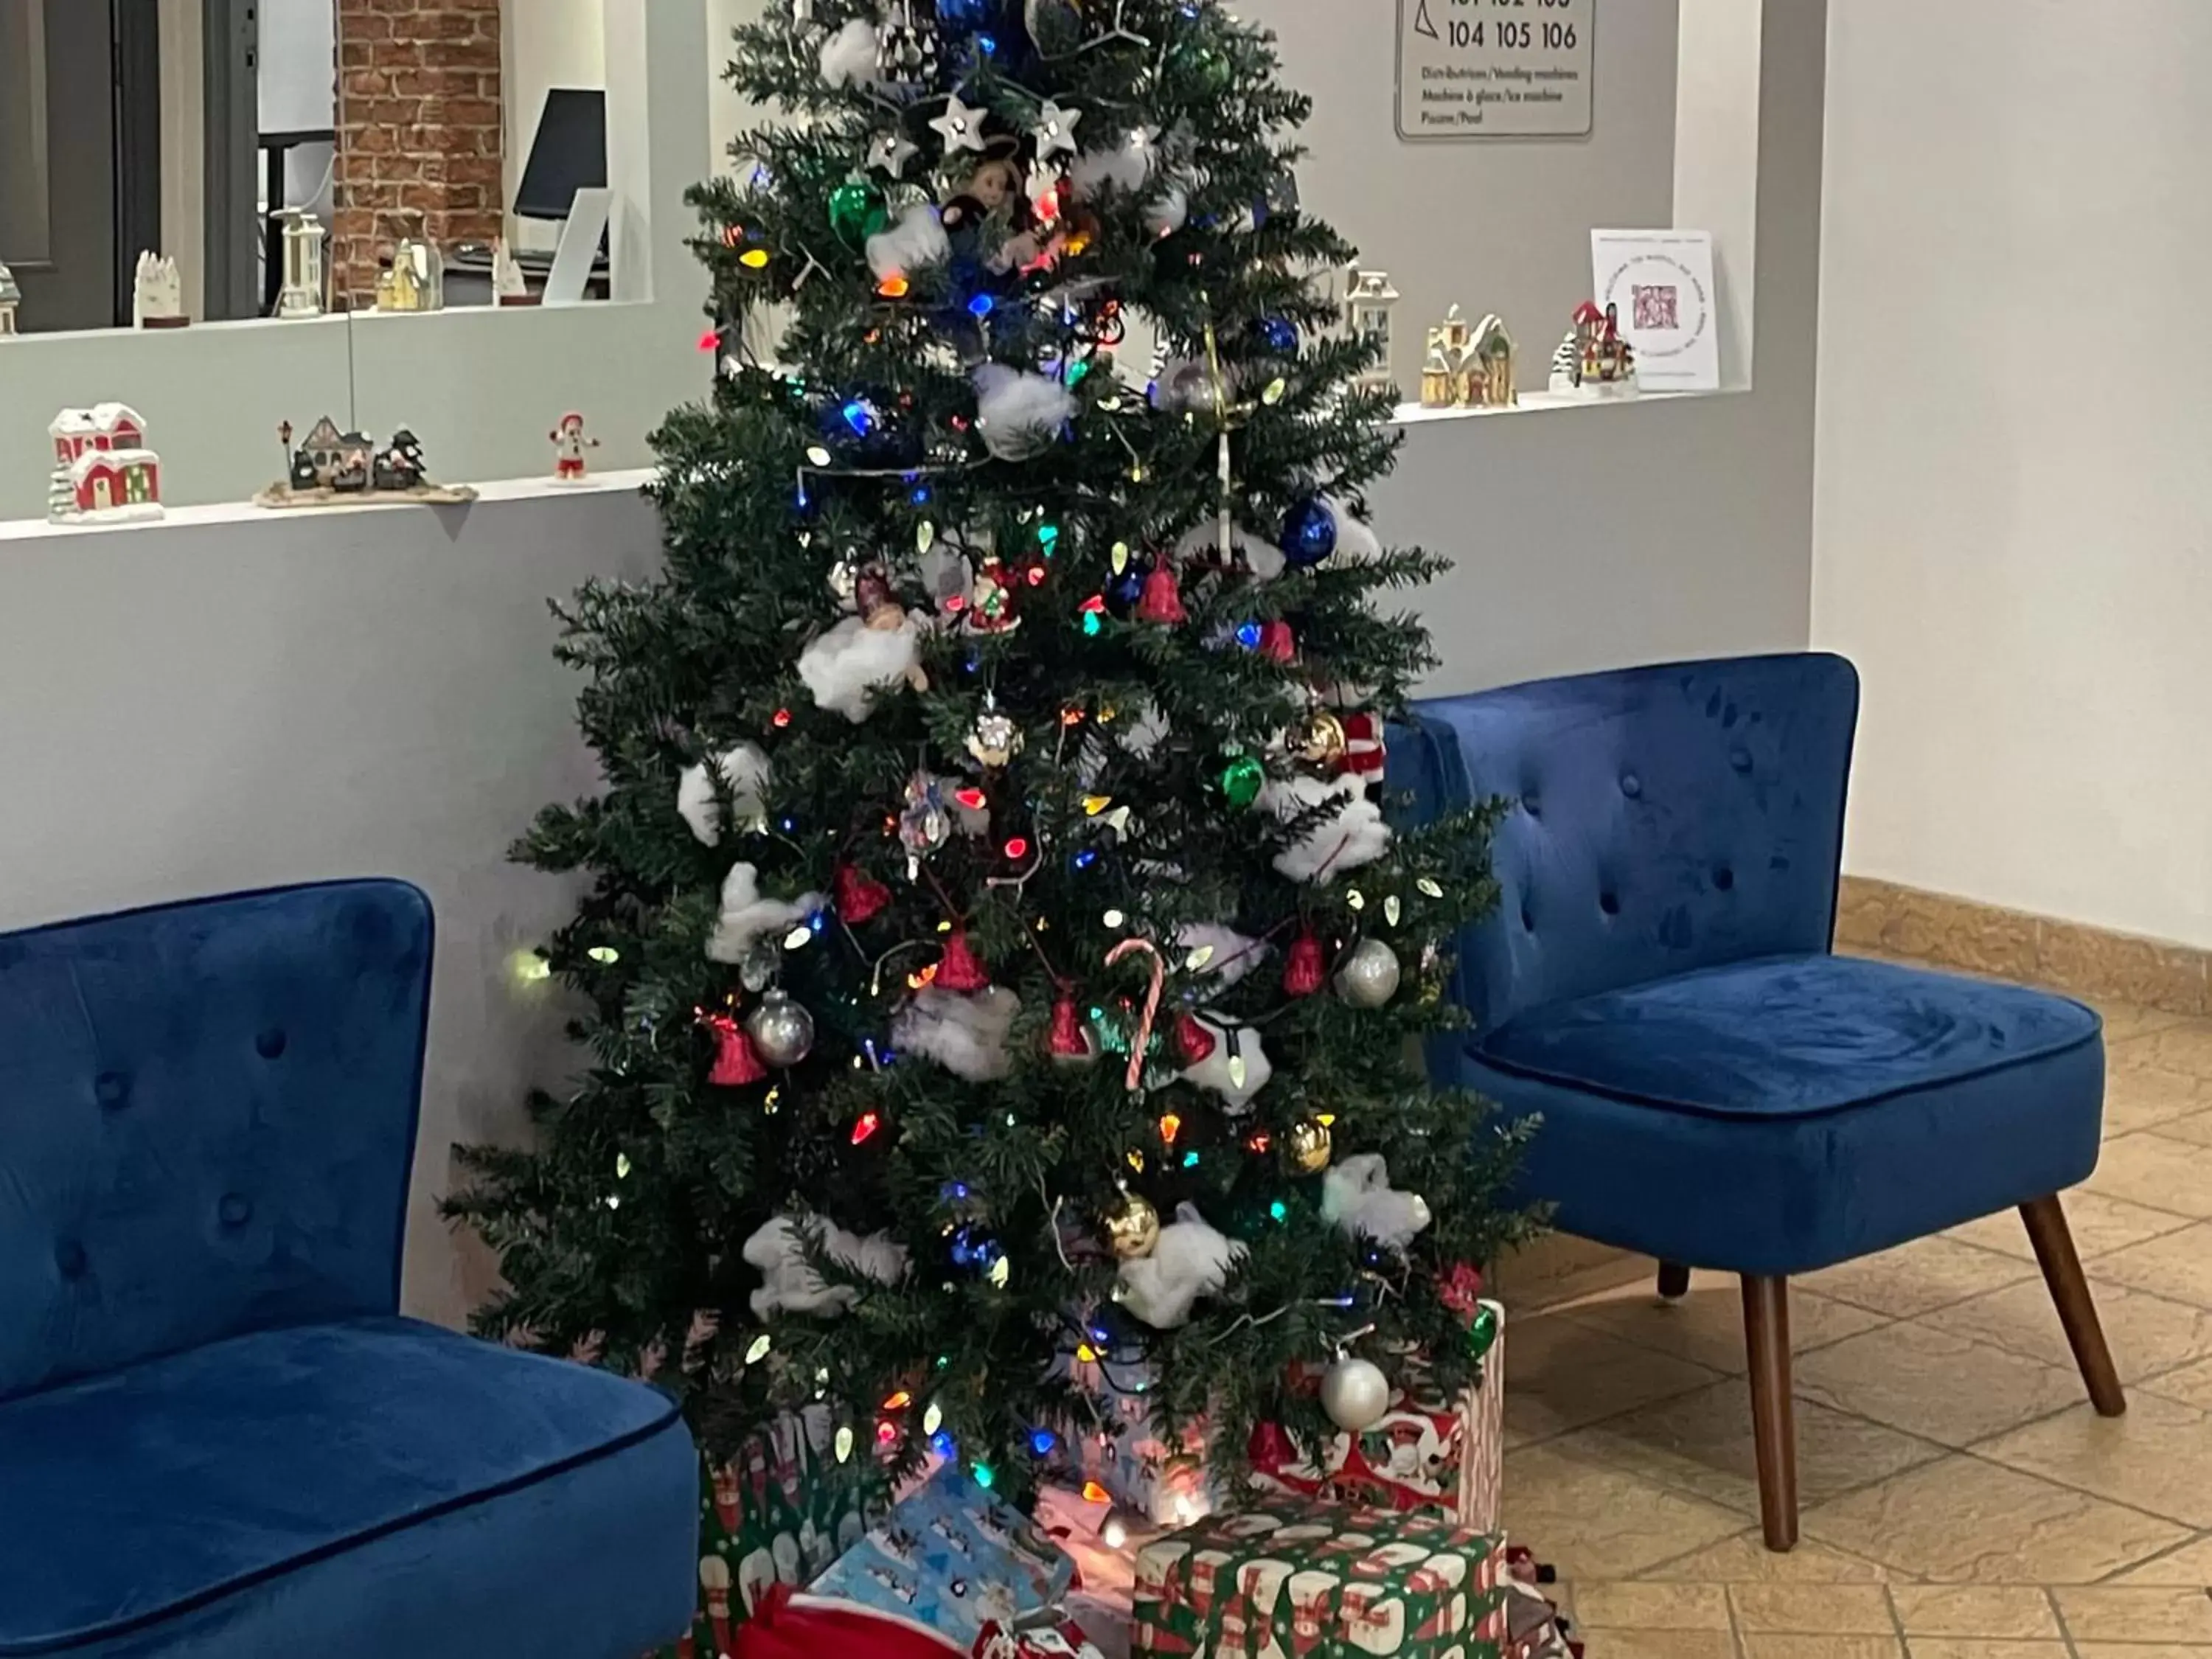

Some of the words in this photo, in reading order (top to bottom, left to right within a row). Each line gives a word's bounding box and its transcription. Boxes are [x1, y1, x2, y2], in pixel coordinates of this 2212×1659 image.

[1449, 21, 1484, 47] 104
[1497, 21, 1531, 48] 105
[1543, 23, 1576, 49] 106
